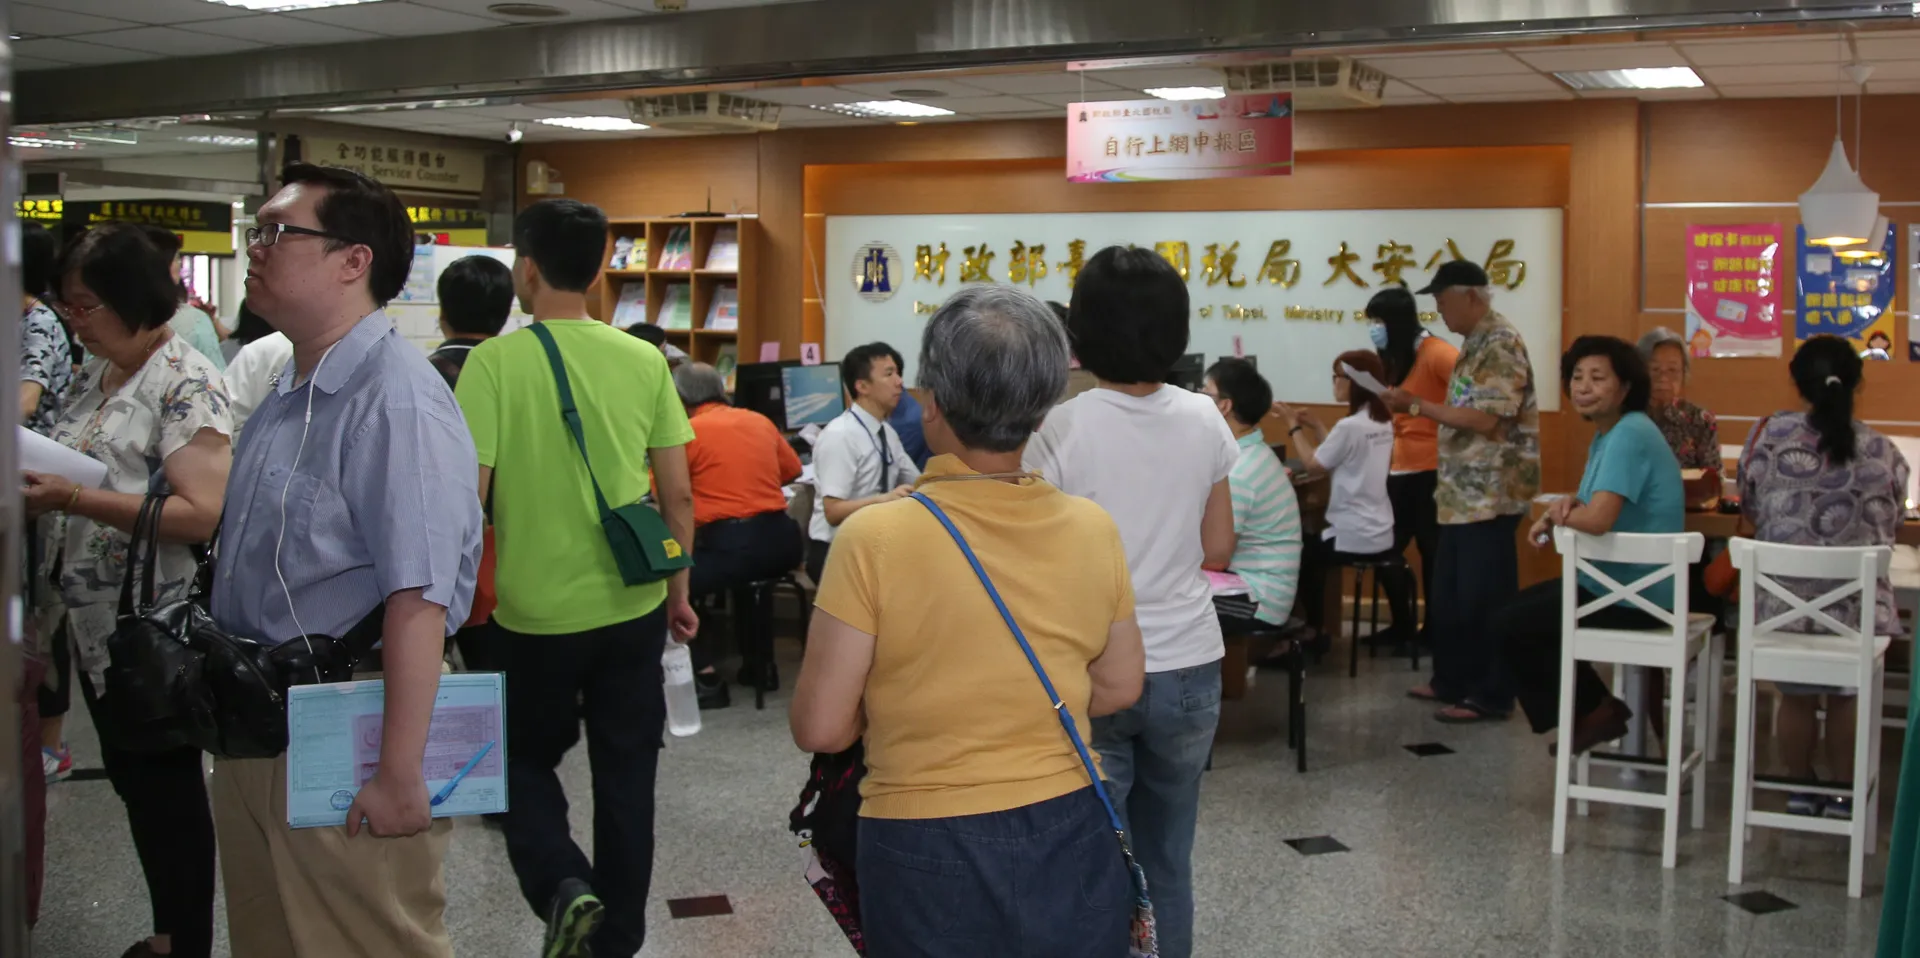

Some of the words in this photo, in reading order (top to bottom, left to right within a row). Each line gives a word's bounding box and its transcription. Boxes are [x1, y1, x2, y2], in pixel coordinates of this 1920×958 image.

[1104, 129, 1257, 157] 自行上網申報區
[371, 164, 413, 180] Service
[416, 168, 460, 183] Counter
[913, 237, 1300, 291] 財政部臺國稅局
[1284, 304, 1345, 323] Ministry
[806, 346, 815, 361] 4
